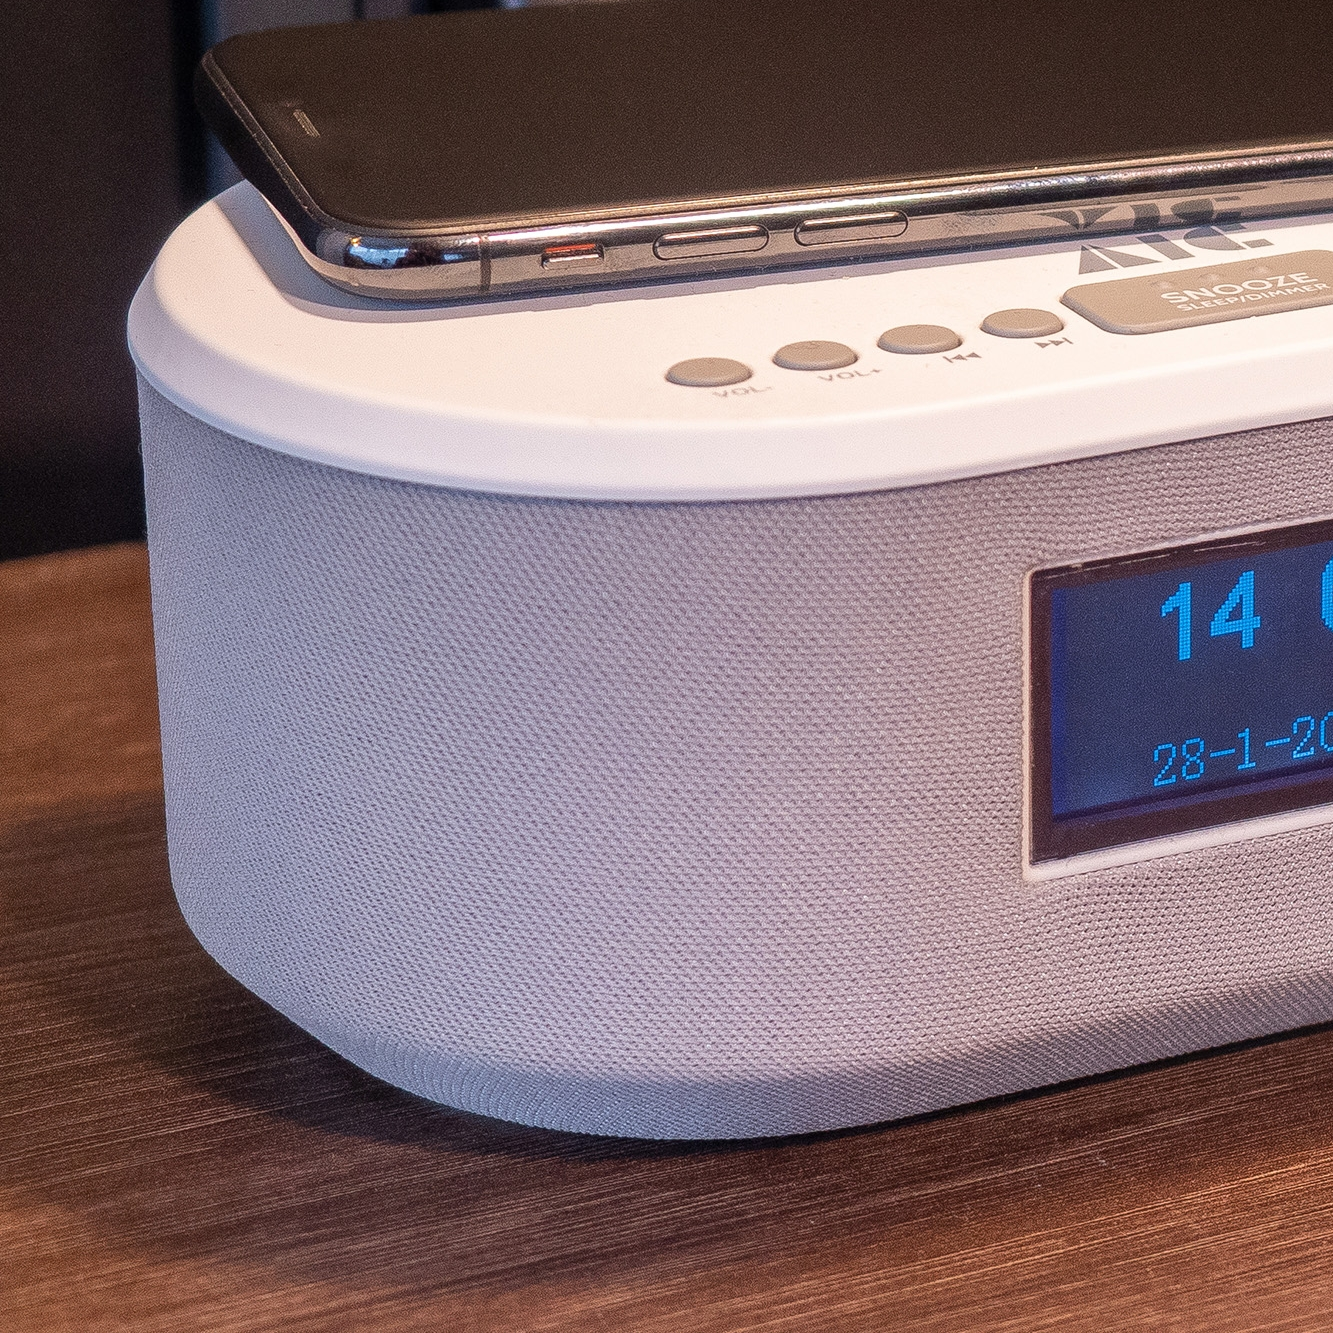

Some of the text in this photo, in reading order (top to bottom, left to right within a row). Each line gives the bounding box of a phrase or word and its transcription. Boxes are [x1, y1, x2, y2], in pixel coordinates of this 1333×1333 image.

[1160, 271, 1319, 304] SNOOZE
[1176, 282, 1331, 312] SLEEP/DIMMER
[1160, 569, 1262, 661] 14
